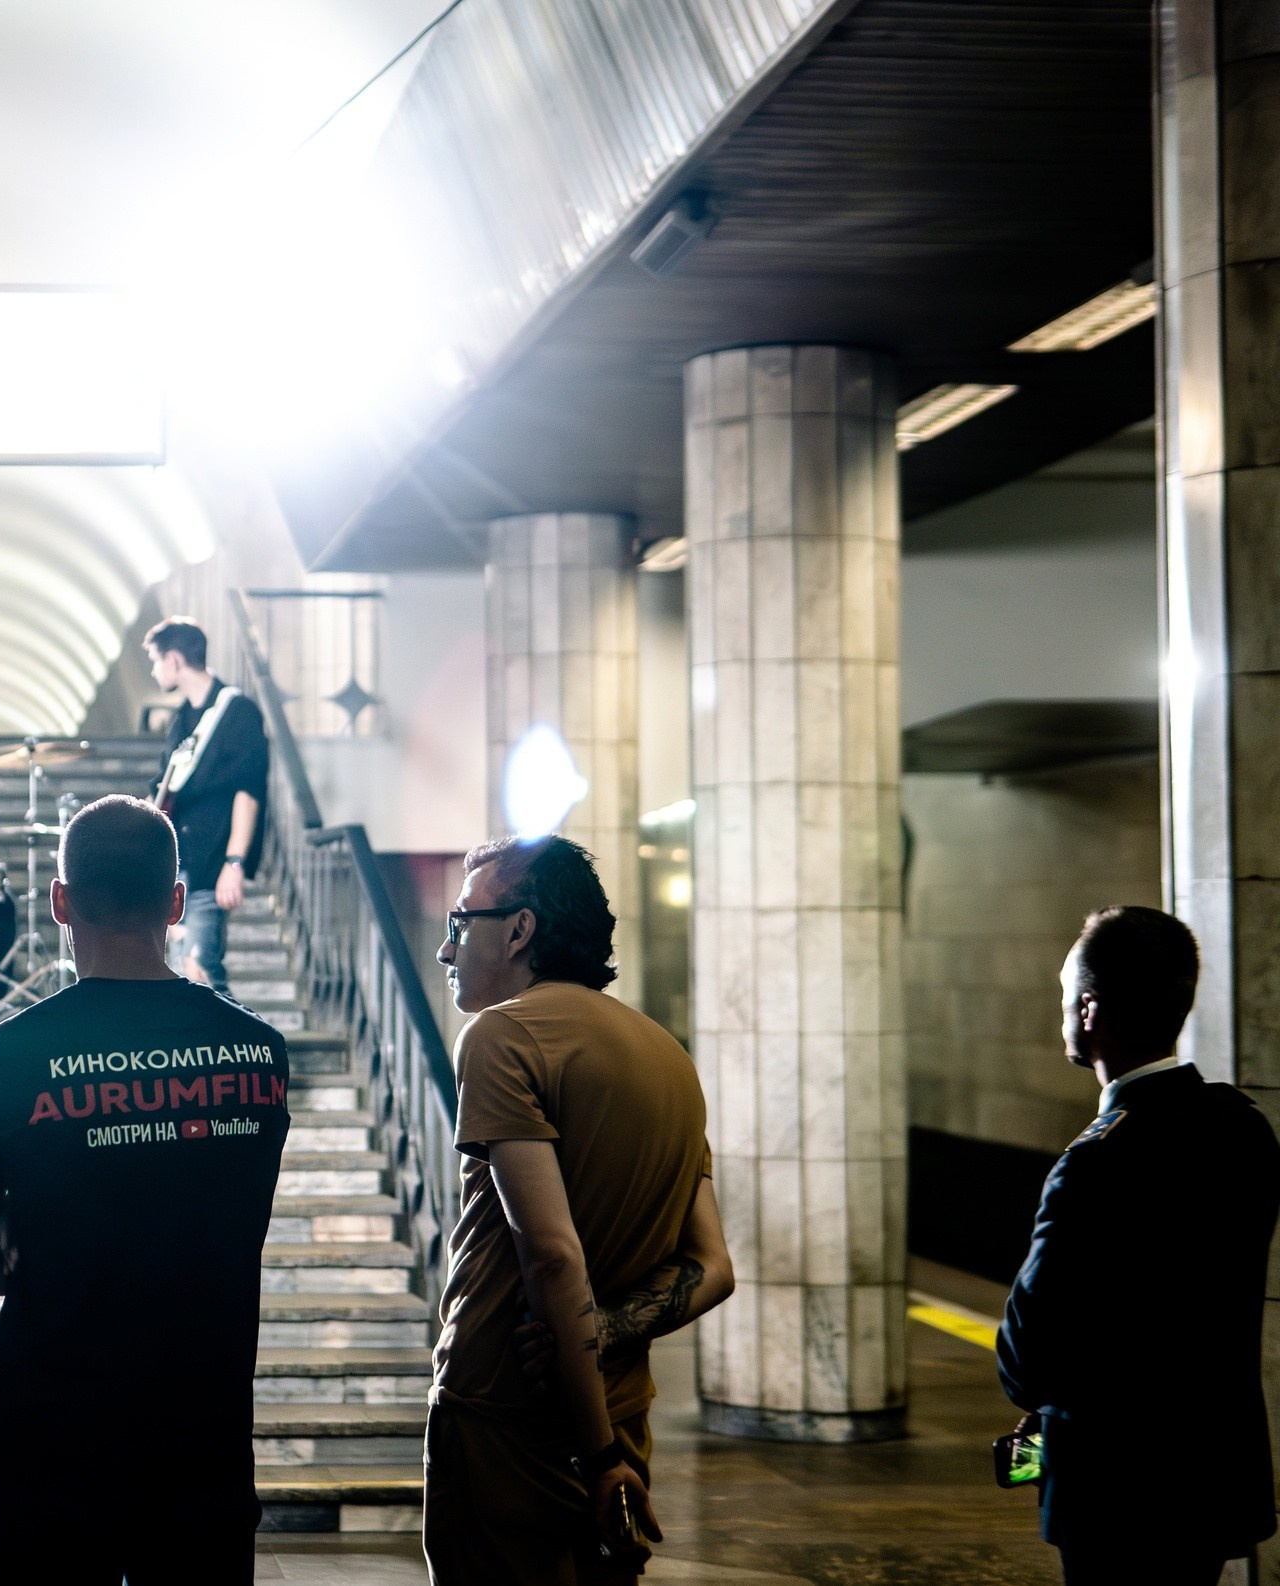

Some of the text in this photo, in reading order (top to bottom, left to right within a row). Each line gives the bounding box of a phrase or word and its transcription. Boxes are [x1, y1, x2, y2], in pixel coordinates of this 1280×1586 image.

[49, 1044, 274, 1079] КИНОКОМПАНИЯ
[28, 1072, 286, 1126] AURUMFILM
[86, 1117, 260, 1148] СМОТРИ НА YouTube
